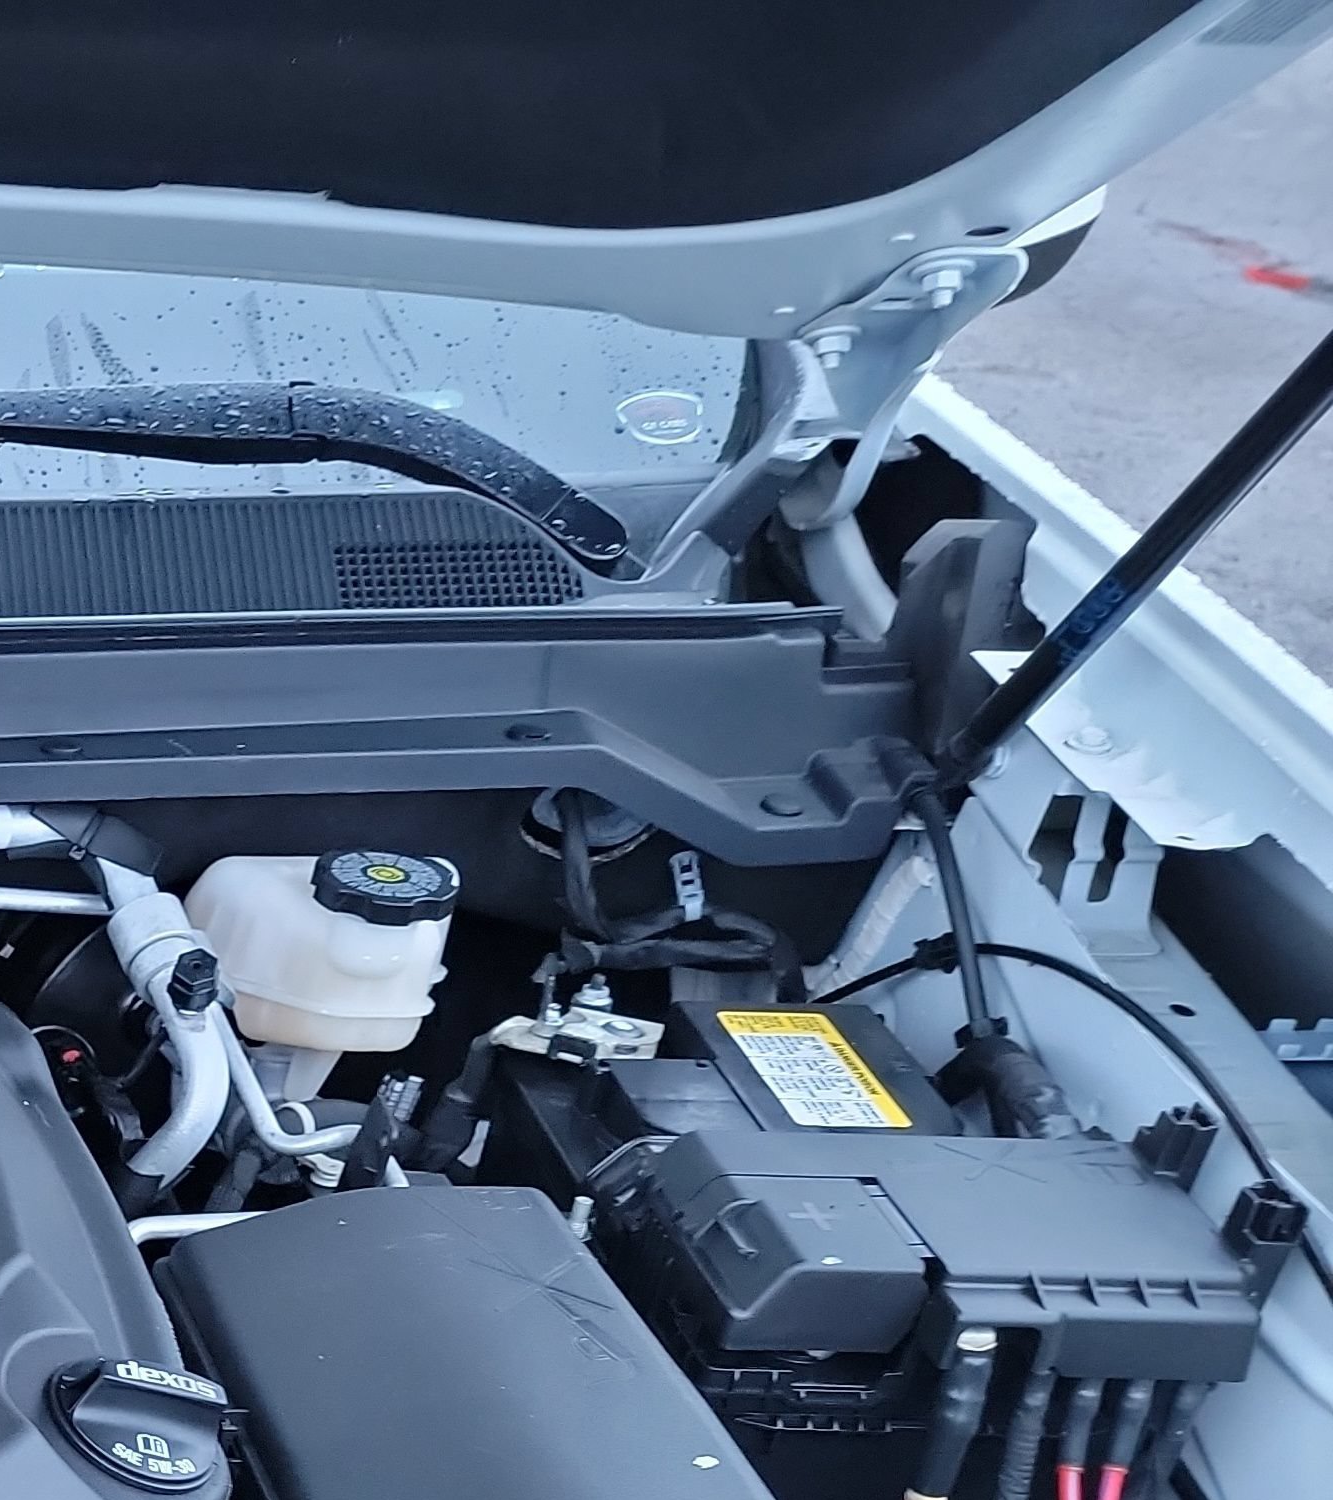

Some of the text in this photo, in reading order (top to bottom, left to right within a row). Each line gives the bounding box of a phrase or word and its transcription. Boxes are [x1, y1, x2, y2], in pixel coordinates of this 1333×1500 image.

[116, 1361, 218, 1399] dexos
[111, 1442, 197, 1475] SAE 5W-30
